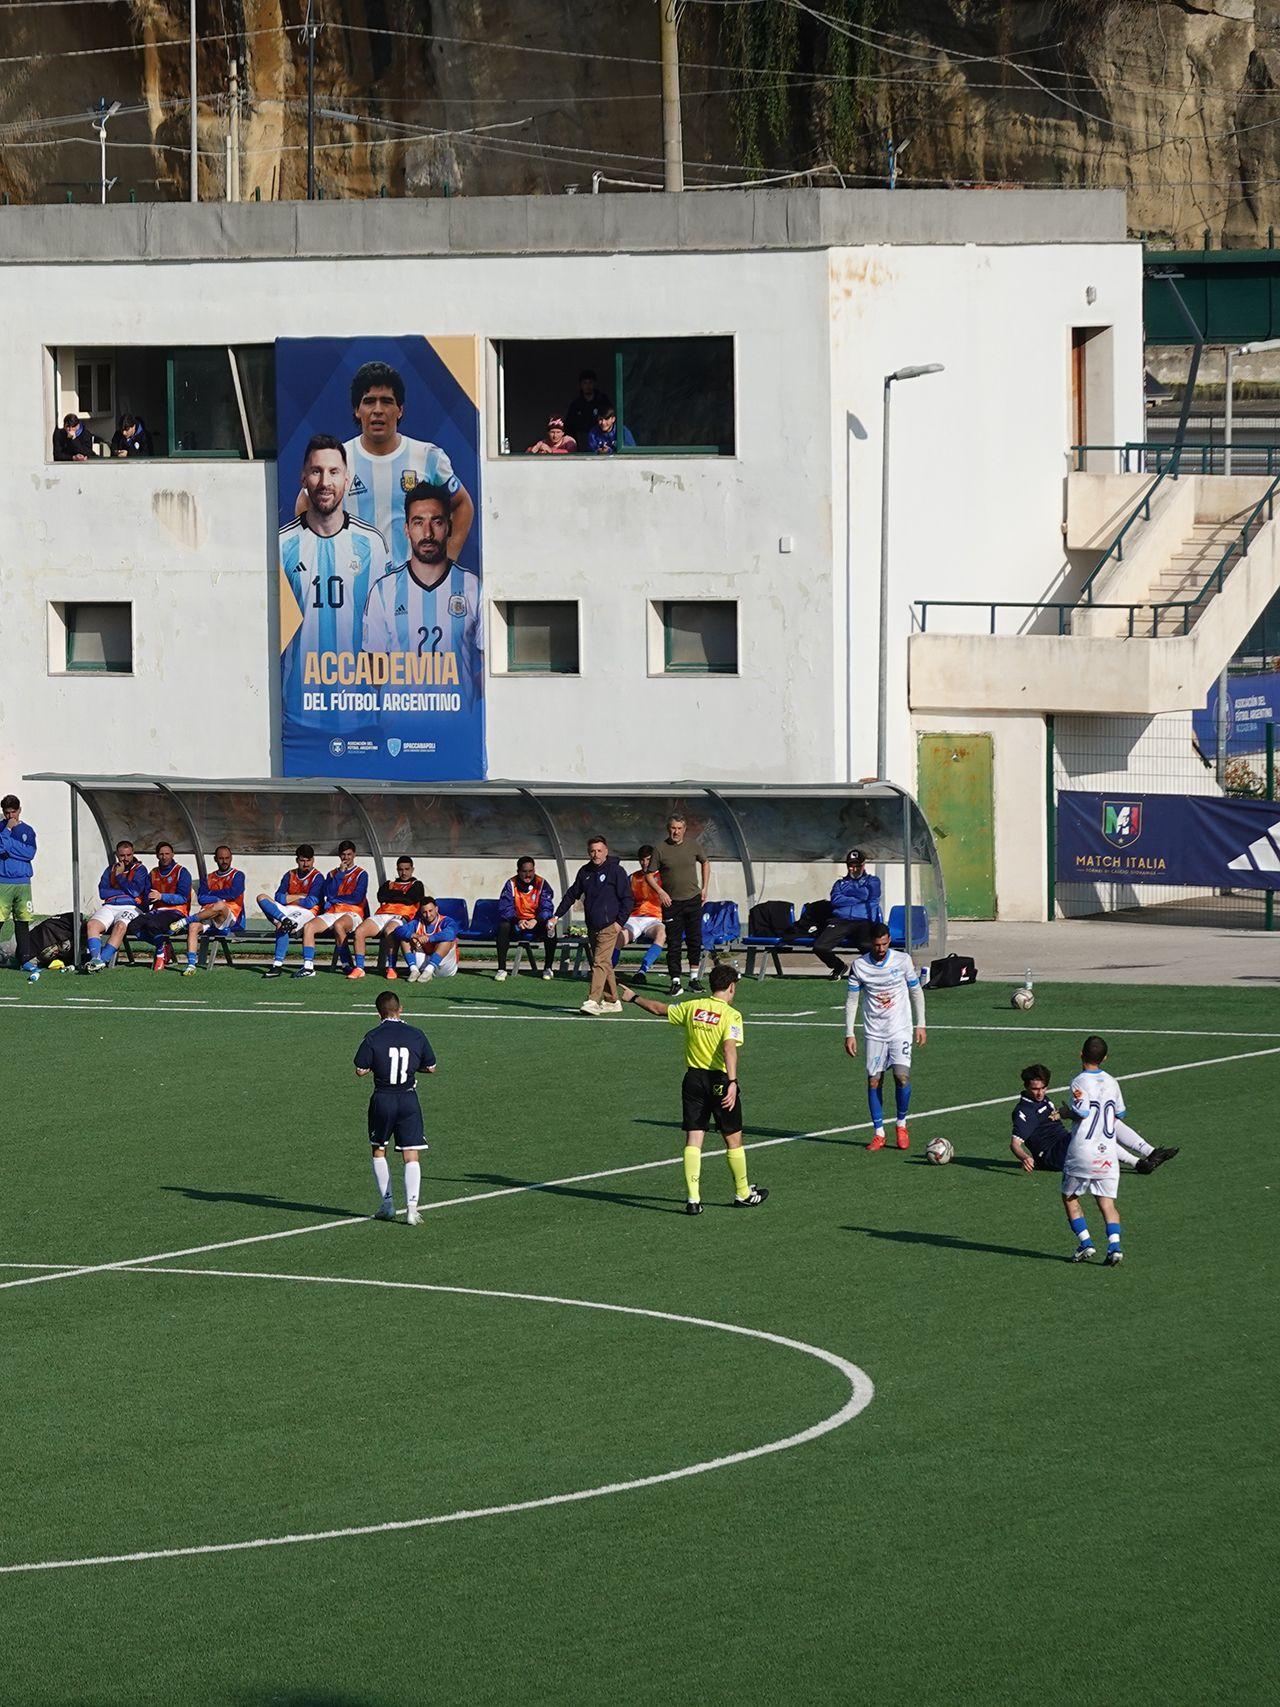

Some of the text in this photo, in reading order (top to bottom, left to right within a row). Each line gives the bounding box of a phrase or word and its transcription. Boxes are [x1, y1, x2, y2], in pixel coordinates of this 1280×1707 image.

[311, 575, 345, 609] 10
[417, 625, 443, 657] 22
[303, 651, 460, 686] ACCADEMIA
[303, 689, 461, 711] DEL FÚTBOL ARGENTINO
[1076, 855, 1167, 869] MATCH ITALIA
[389, 1047, 410, 1085] 11
[1085, 1099, 1116, 1140] 70
